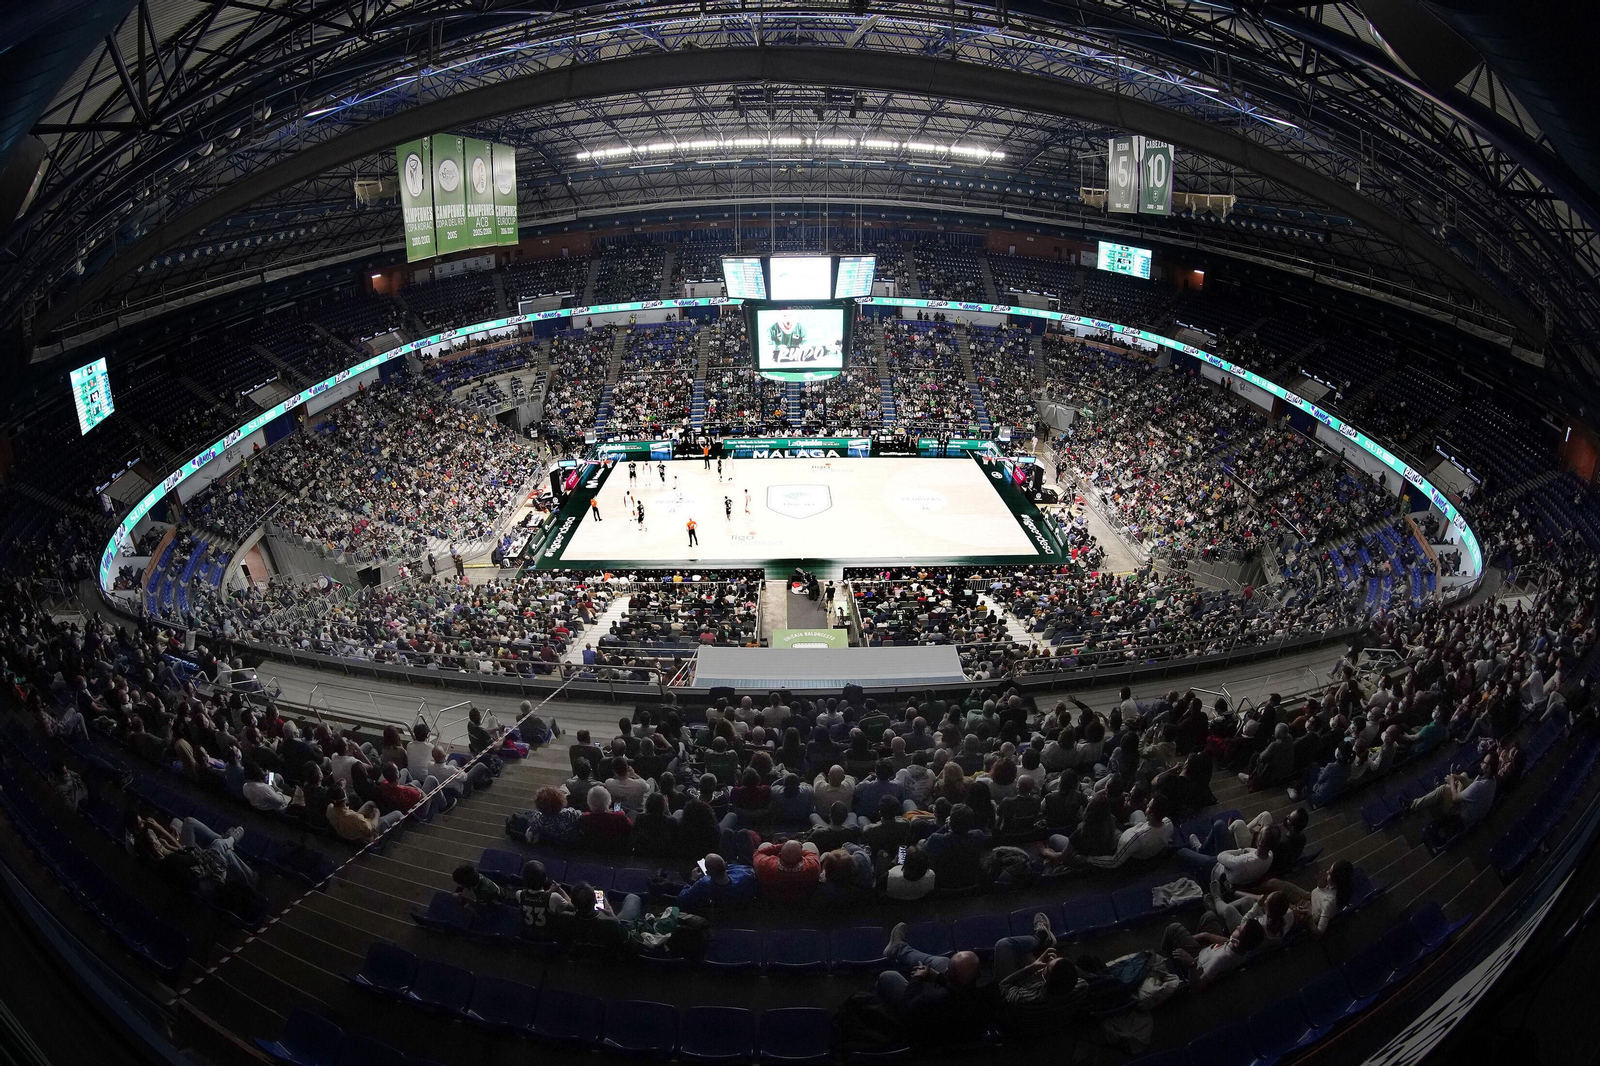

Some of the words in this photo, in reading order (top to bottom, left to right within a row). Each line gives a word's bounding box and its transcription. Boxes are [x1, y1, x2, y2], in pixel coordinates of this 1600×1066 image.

[1118, 156, 1128, 187] 5
[1148, 154, 1165, 187] 10
[405, 207, 432, 223] CAMPEONES
[436, 204, 465, 219] CAMPEONES
[467, 204, 494, 217] CAMPEONES
[496, 205, 517, 217] CAMPEONES
[436, 219, 448, 228] COPA
[448, 218, 457, 226] DEL
[476, 217, 489, 228] ACB
[447, 231, 457, 239] 2005
[753, 449, 840, 458] MÁLAGA
[1363, 439, 1384, 458] SUR
[129, 504, 147, 524] SUR
[804, 632, 836, 640] BALONCESTO
[523, 905, 546, 926] 33
